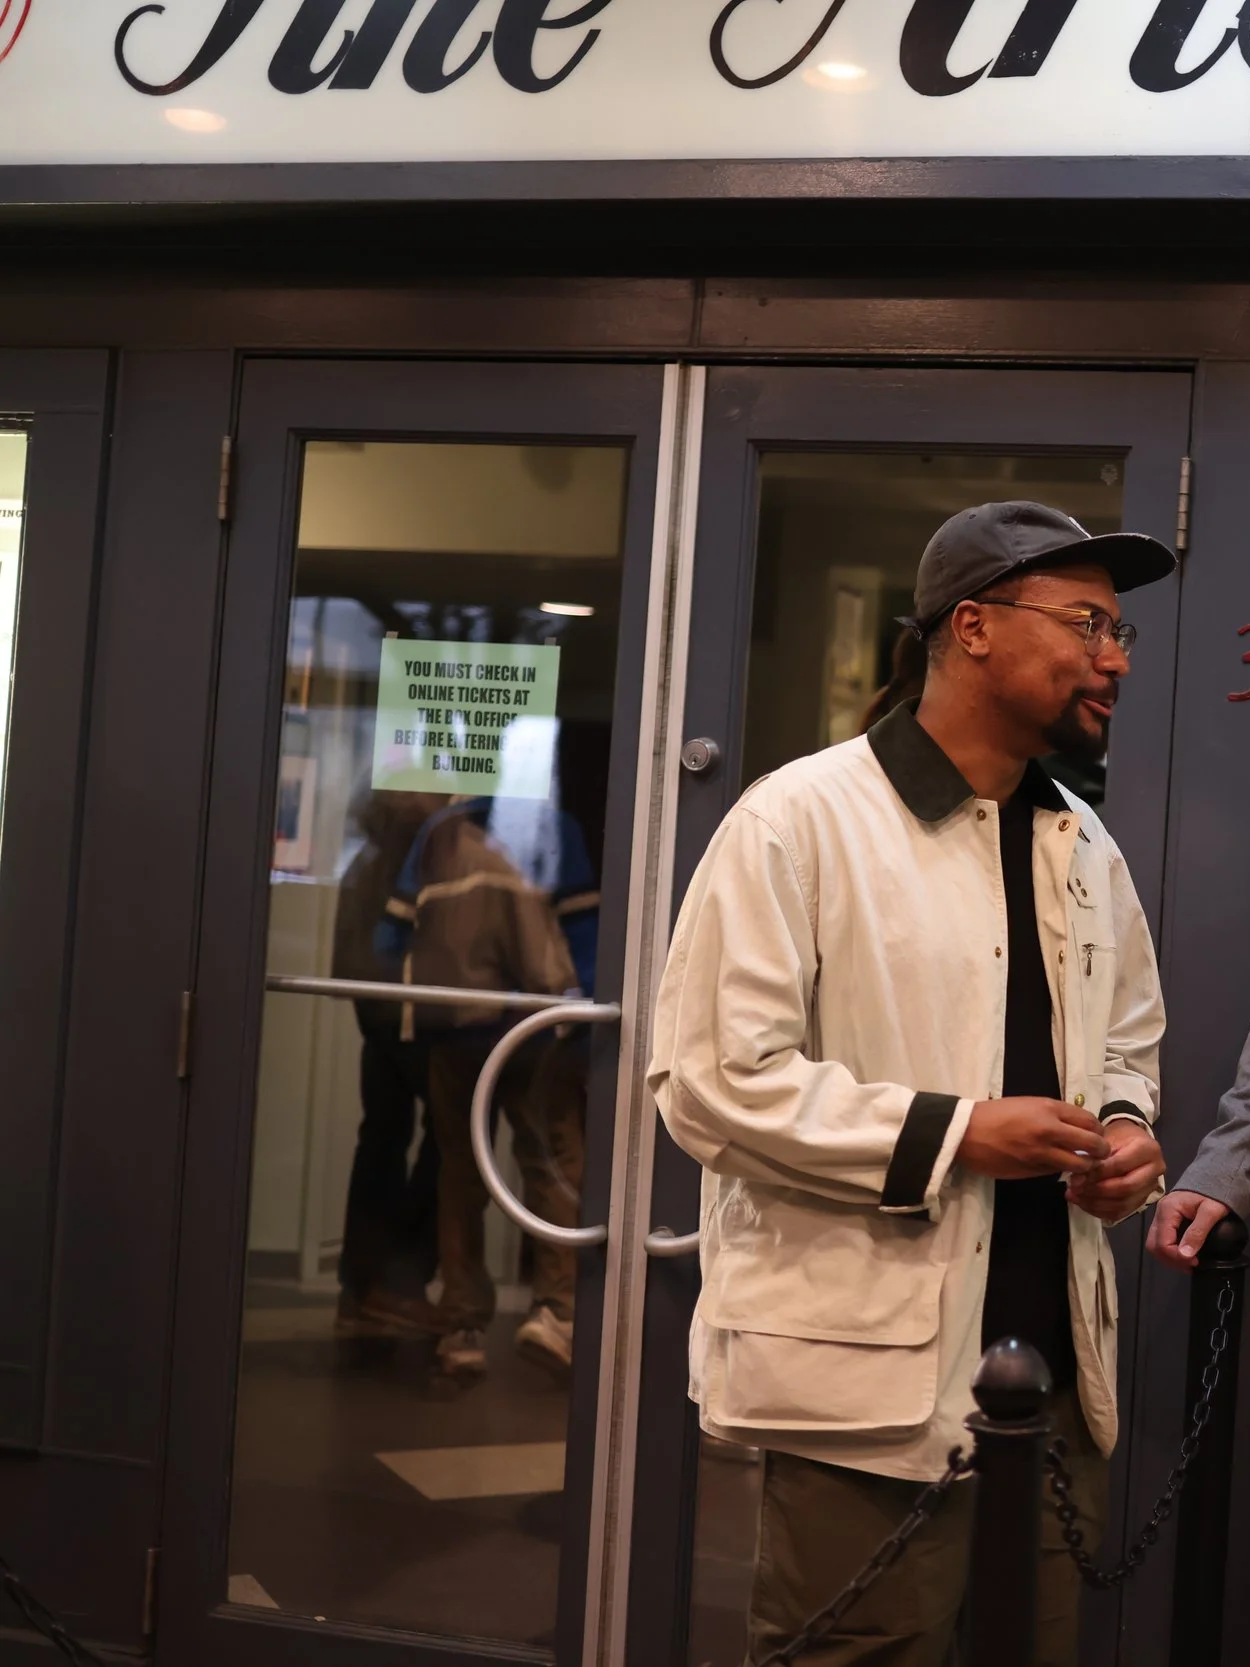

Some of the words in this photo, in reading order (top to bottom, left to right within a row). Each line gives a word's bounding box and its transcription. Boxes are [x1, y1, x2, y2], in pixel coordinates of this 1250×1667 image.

[404, 660, 432, 677] YOU
[434, 662, 472, 679] MUST
[475, 664, 519, 682] CHECK
[522, 666, 536, 683] IN
[408, 684, 454, 702] ONLINE
[458, 687, 511, 705] TICKETS
[513, 689, 530, 706] AT
[417, 707, 441, 724] THE
[394, 729, 444, 748] BEFORE
[432, 755, 496, 774] BUILDING.
